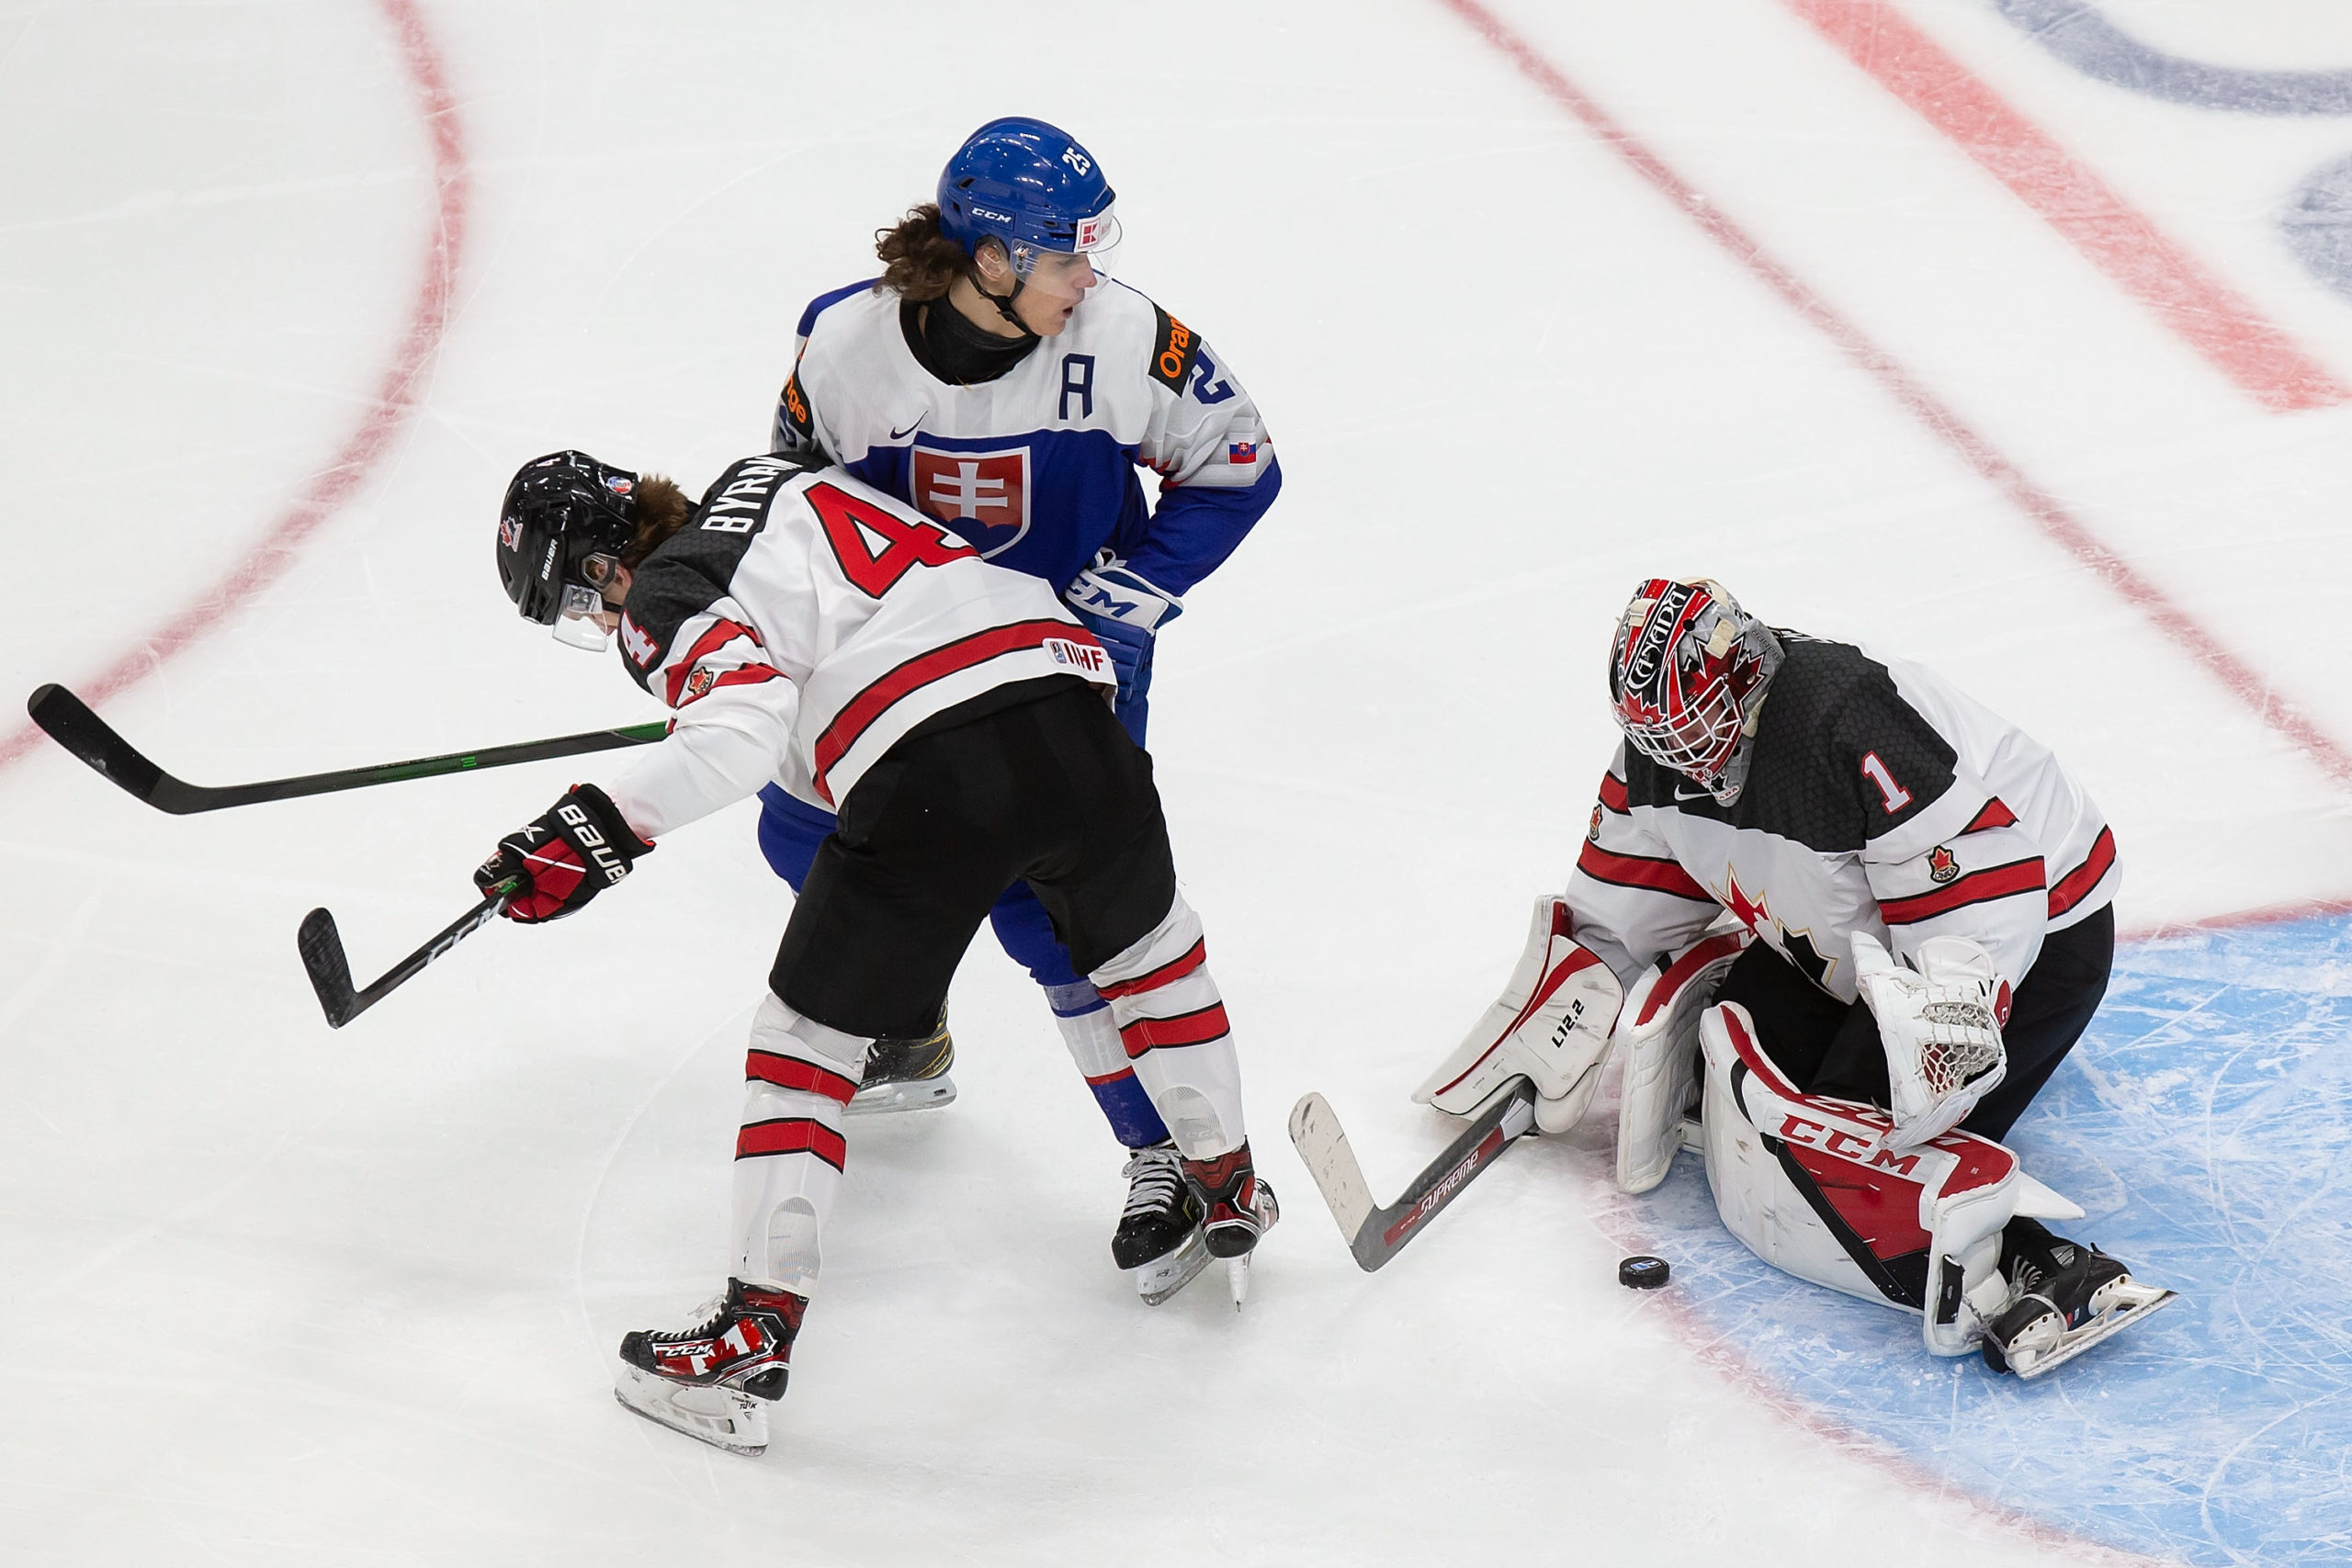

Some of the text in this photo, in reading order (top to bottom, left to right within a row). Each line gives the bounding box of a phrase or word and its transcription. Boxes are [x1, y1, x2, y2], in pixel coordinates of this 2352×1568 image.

[1061, 146, 1091, 177] 25
[971, 207, 1012, 223] CCM
[1058, 353, 1096, 421] A
[1189, 348, 1237, 404] 2
[541, 538, 559, 581] BAUER
[802, 480, 984, 600] 4
[621, 609, 661, 671] 4
[1063, 642, 1104, 672] IIHF
[1860, 750, 1914, 816] 1
[557, 804, 628, 885] BAUE
[1551, 998, 1586, 1049] L12.2
[1779, 1112, 1923, 1178] CCM
[1418, 1150, 1479, 1220] SUPREME
[665, 1343, 714, 1358] CCM
